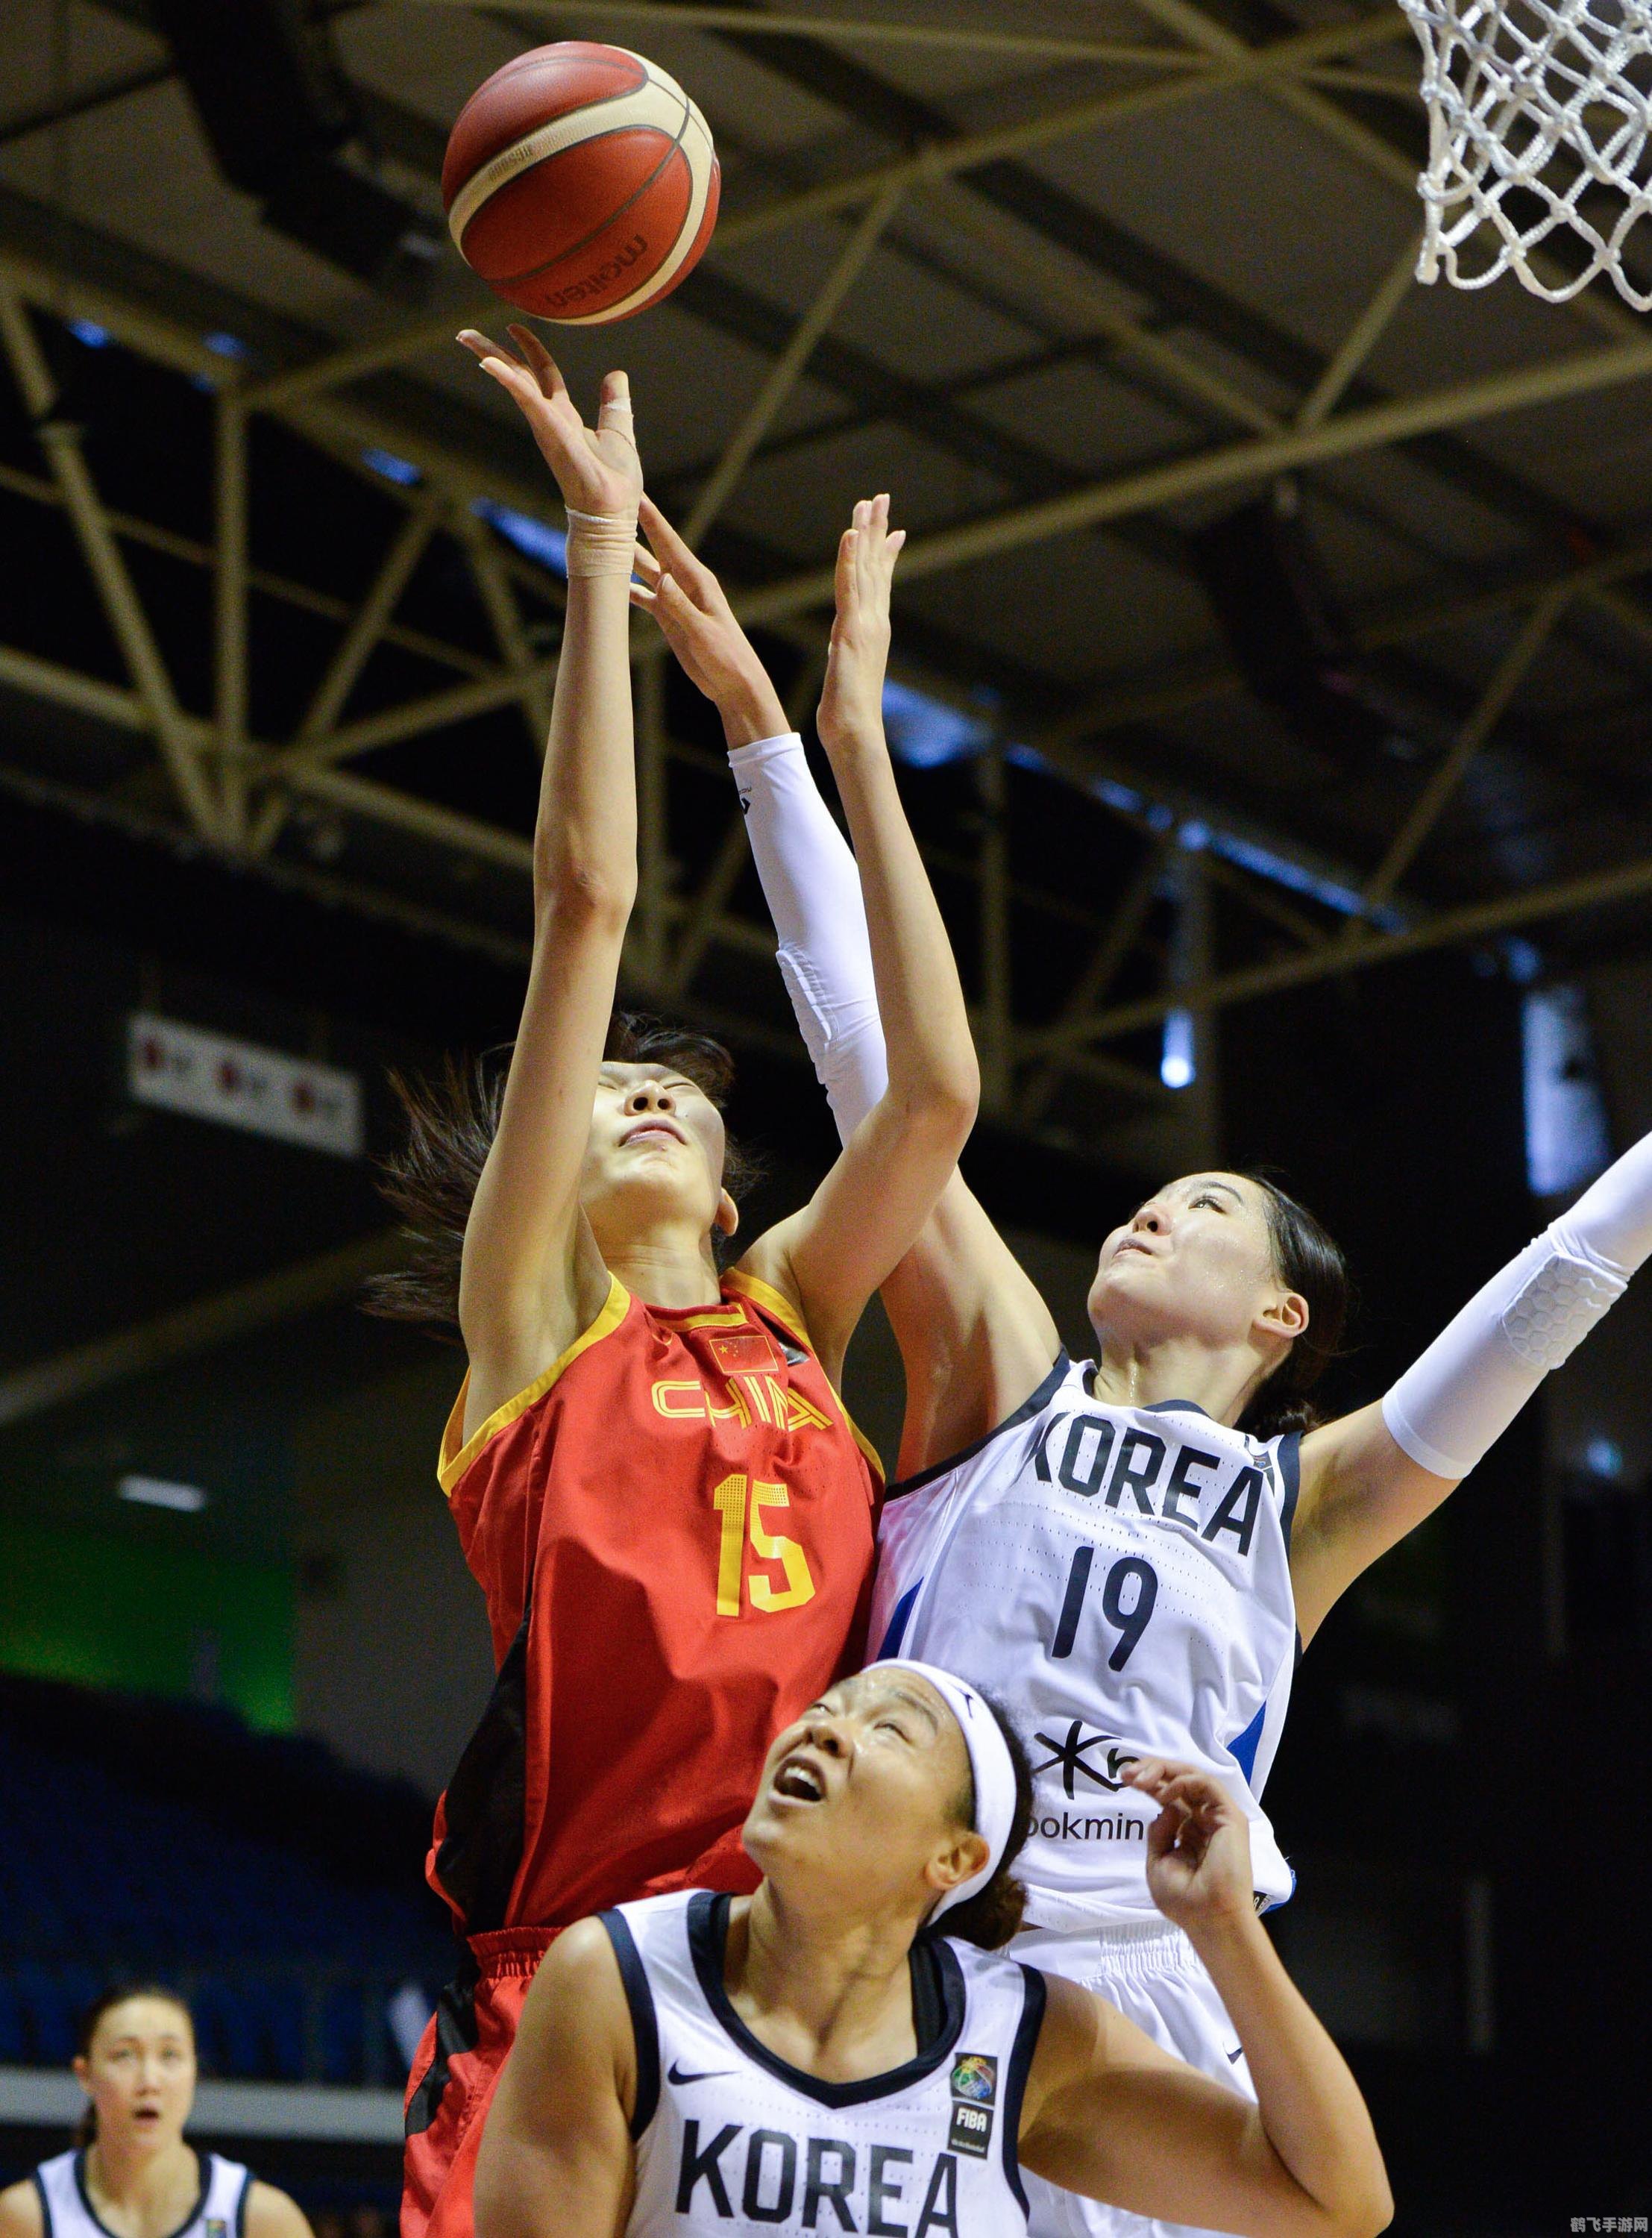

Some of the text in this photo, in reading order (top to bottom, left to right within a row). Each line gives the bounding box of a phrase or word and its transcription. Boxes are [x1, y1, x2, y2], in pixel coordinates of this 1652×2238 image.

[545, 233, 647, 307] molten
[714, 1474, 815, 1617] 15
[1052, 1546, 1158, 1672] 19
[1028, 1811, 1144, 1840] ookmin
[956, 2107, 987, 2132] FIBA
[675, 2119, 959, 2237] KOREA
